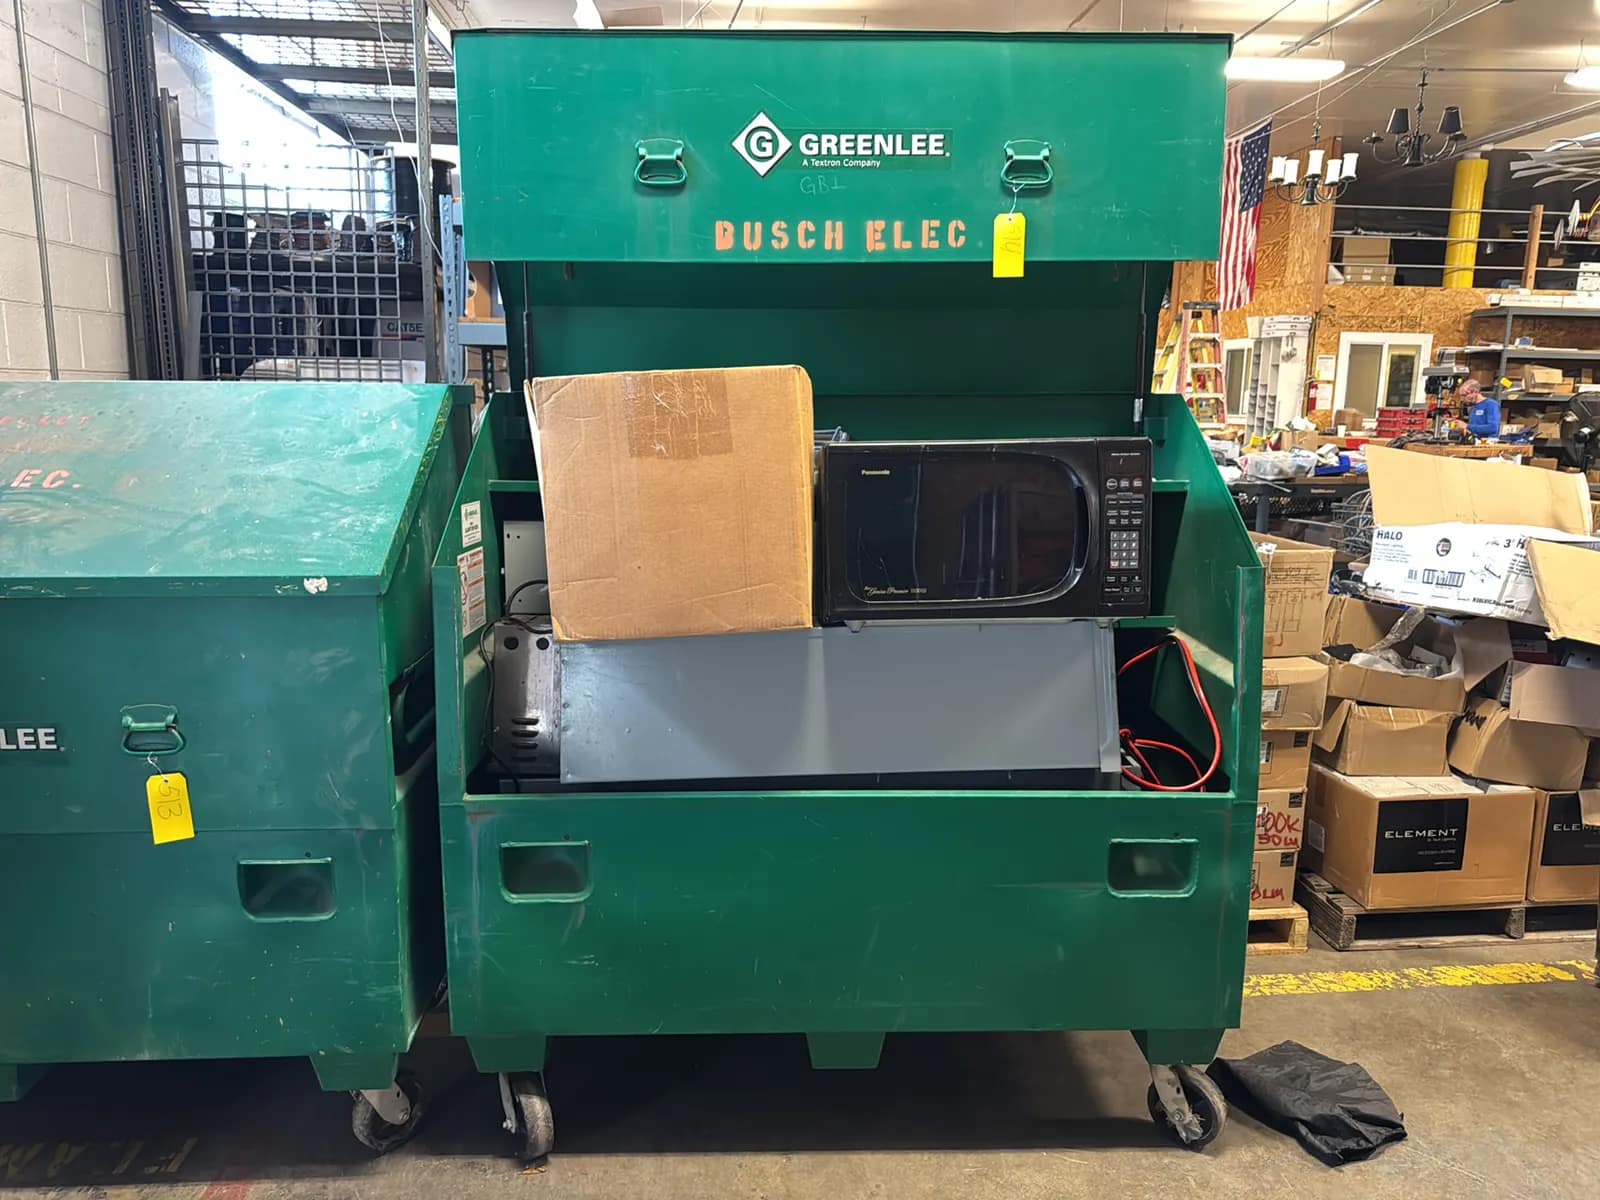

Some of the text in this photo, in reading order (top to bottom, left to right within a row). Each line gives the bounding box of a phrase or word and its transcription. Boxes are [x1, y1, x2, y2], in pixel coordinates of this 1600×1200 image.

[811, 158, 840, 167] Textron
[843, 158, 881, 168] Company
[715, 220, 966, 252] BUSCH ELEC
[1376, 530, 1403, 541] HALO
[1384, 828, 1459, 839] ELEMENT
